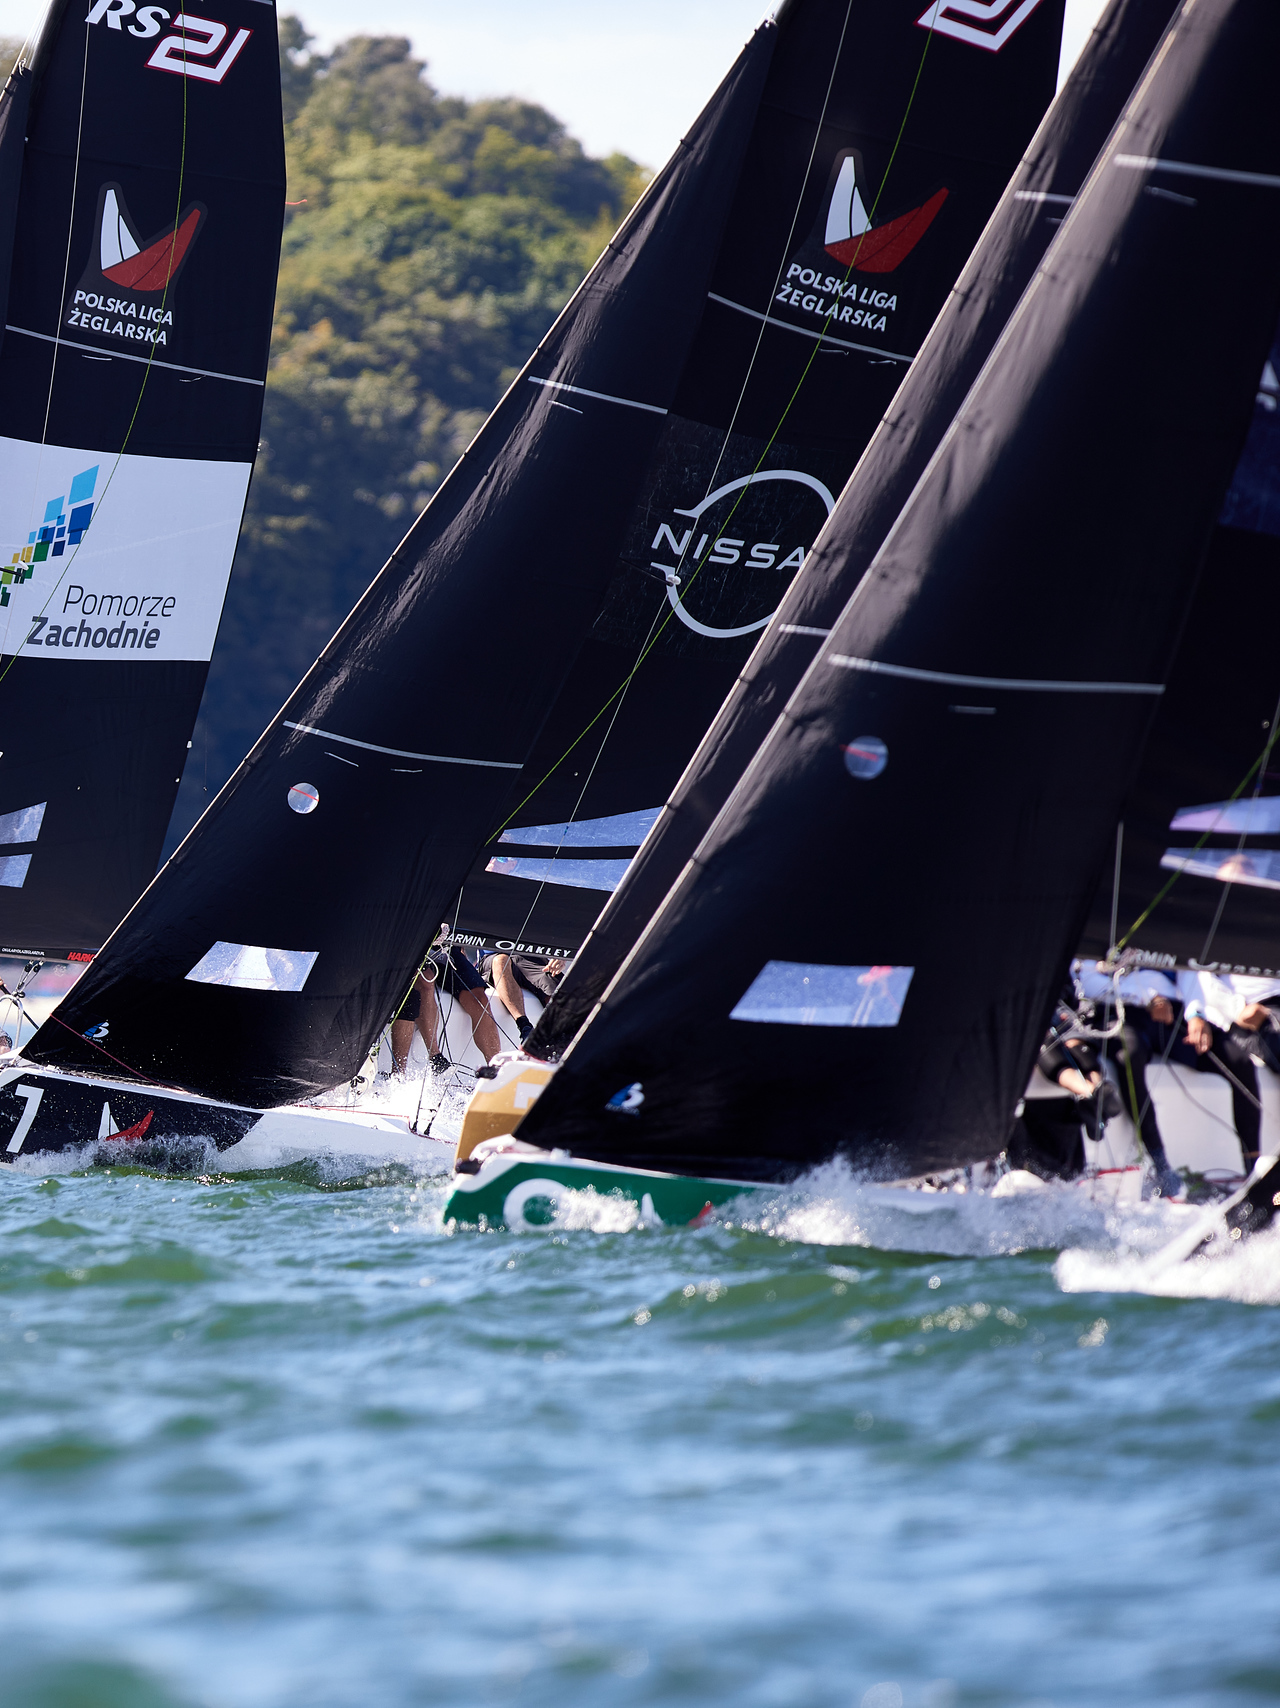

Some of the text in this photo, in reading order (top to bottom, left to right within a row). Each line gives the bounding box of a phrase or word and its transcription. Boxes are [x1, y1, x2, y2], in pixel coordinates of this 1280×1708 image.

[786, 263, 897, 311] POLSKA LIGA
[74, 290, 173, 326] POLSKA LIGA
[776, 282, 887, 332] ŻEGLARSKA
[67, 307, 167, 346] ŻEGLARSKA
[651, 523, 805, 570] NISSA
[63, 585, 176, 617] Pomorze
[27, 616, 161, 649] Zachodnie
[67, 952, 96, 963] HARK
[445, 933, 486, 947] ARMIN
[516, 945, 572, 957] OAKLEY
[6, 1084, 45, 1153] 7
